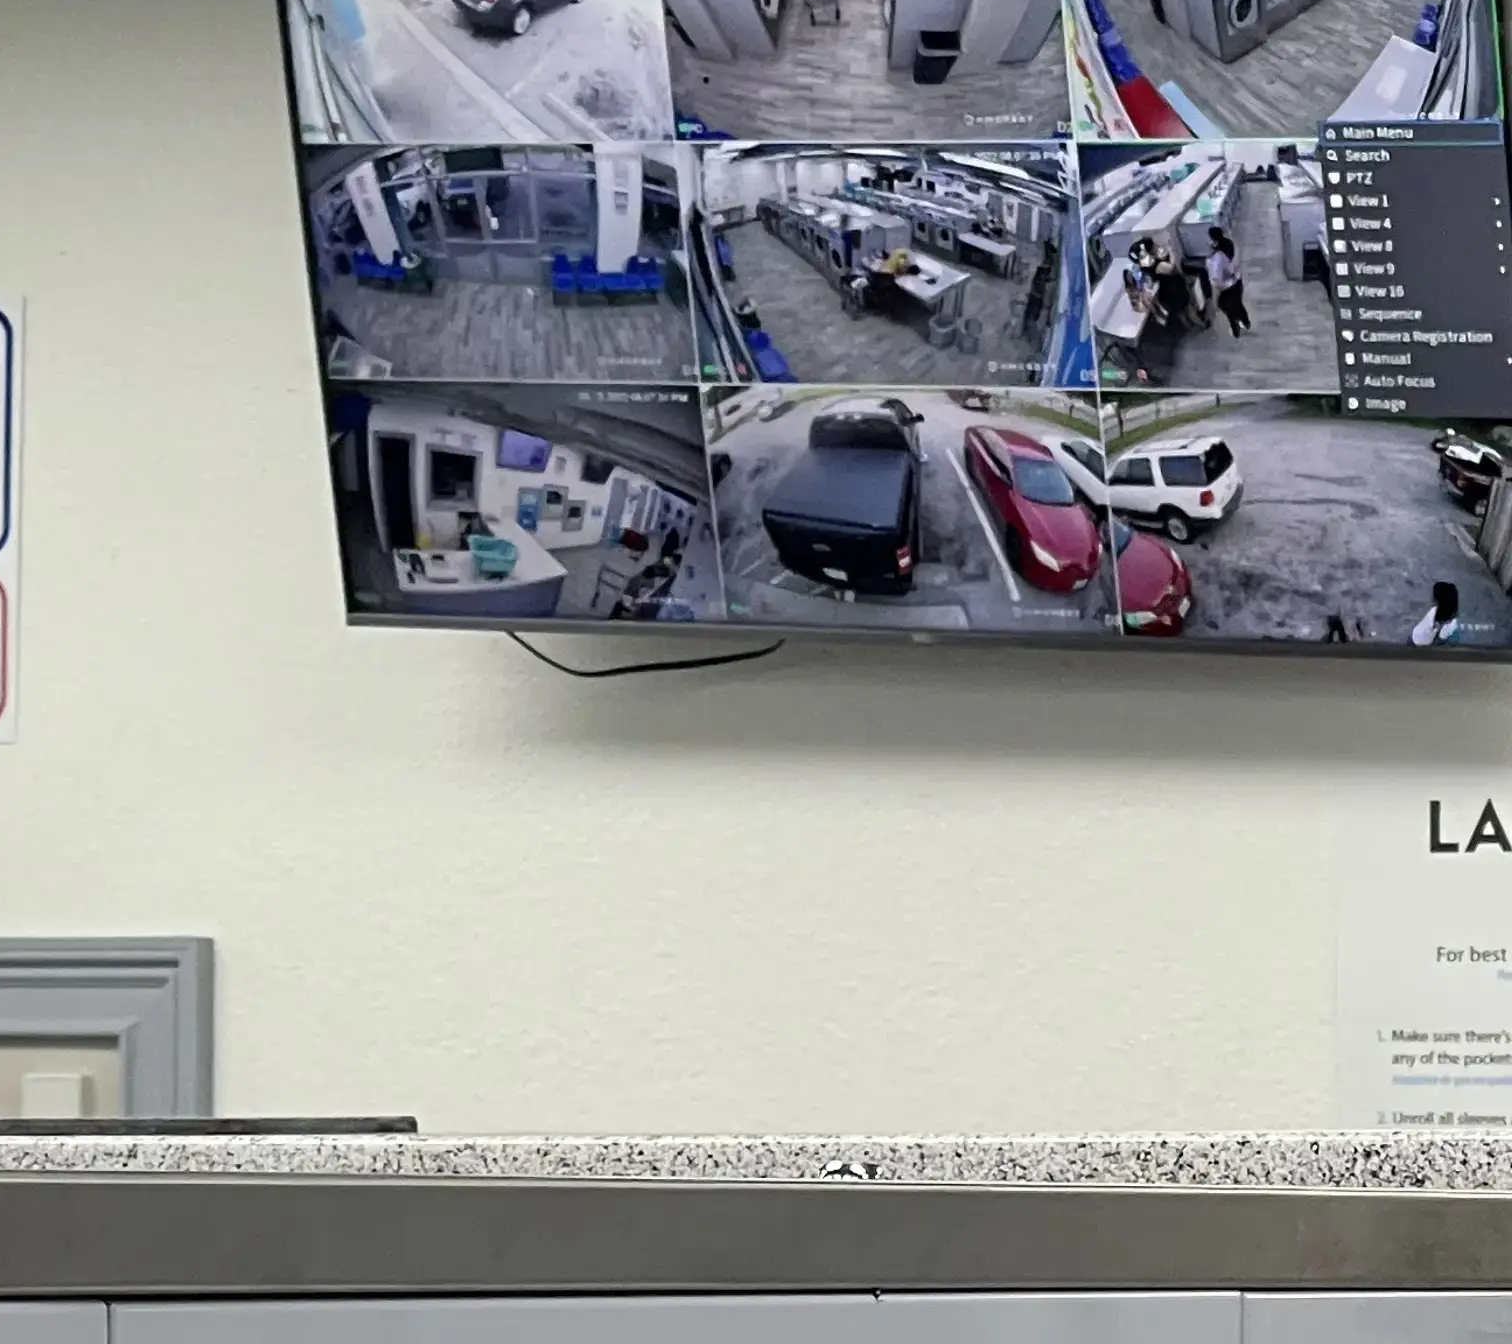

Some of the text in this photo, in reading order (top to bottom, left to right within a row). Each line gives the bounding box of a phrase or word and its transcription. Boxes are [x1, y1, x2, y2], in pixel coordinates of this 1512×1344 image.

[1342, 126, 1415, 141] Main Menu
[1345, 148, 1392, 163] Search
[1346, 171, 1374, 186] PTZ
[1346, 194, 1380, 209] View
[1349, 217, 1382, 231] View
[1351, 239, 1384, 254] View
[1353, 262, 1386, 276] View
[1354, 284, 1387, 299] View
[1358, 307, 1424, 323] Sequence
[1360, 329, 1494, 347] Camera Registration
[1362, 352, 1412, 366] Manual
[1364, 374, 1437, 389] Auto Focus
[1365, 397, 1408, 414] Image
[1436, 945, 1508, 963] For best
[1391, 1029, 1429, 1044] Make
[1432, 1030, 1461, 1044] sure
[1391, 1054, 1416, 1069] any
[1419, 1051, 1434, 1066] of
[1437, 1051, 1460, 1066] the
[1392, 1111, 1434, 1126] Unroll
[1438, 1111, 1454, 1126] all
[1457, 1111, 1507, 1127] sleeves
